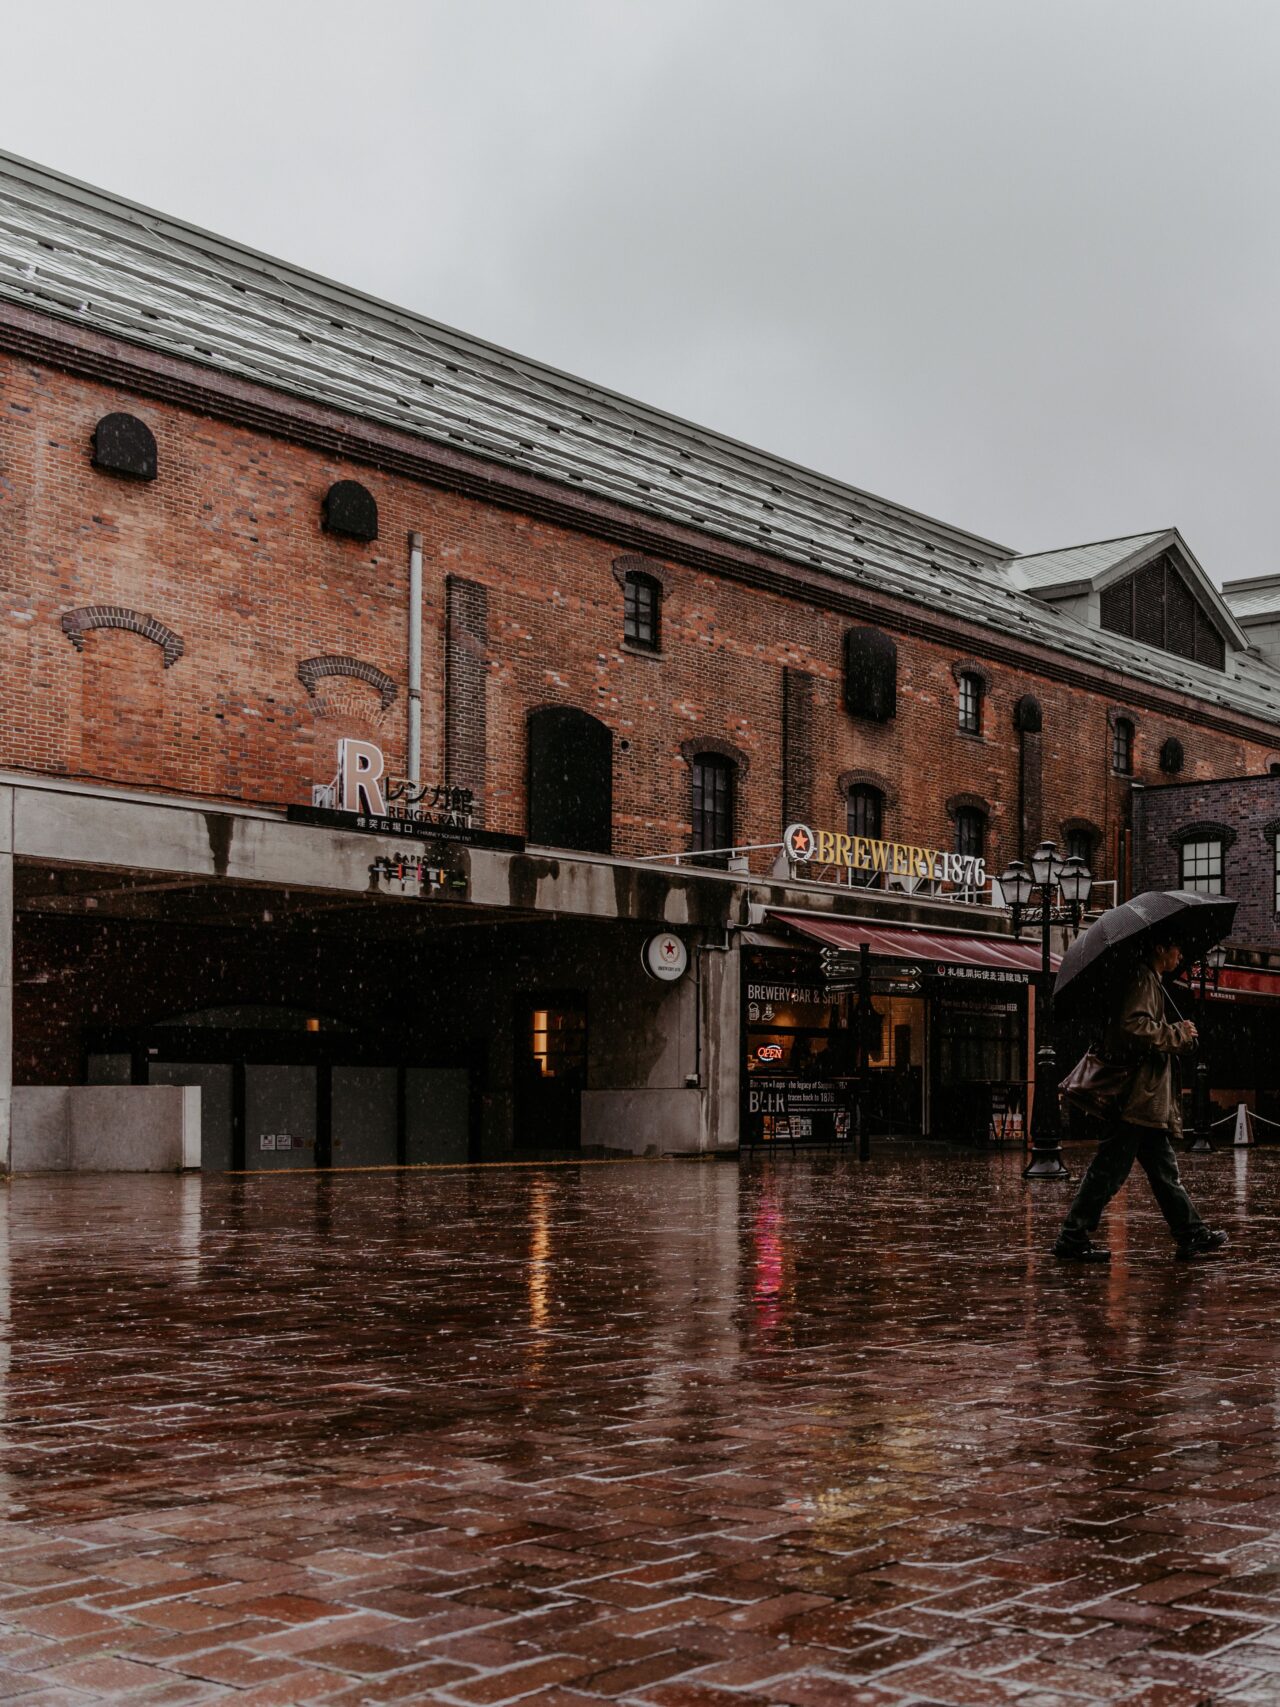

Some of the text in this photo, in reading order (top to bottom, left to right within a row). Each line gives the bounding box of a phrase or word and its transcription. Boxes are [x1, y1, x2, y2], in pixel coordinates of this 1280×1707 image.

[338, 738, 386, 817] R
[384, 776, 473, 816] レンガ館
[356, 816, 413, 834] 煙突広場口
[817, 829, 986, 887] BREWERY 1876
[747, 984, 791, 1001] BREWERY
[793, 988, 811, 1003] BAR
[1006, 1003, 1018, 1012] BEER
[757, 1047, 783, 1059] OPEN
[802, 1093, 814, 1102] back
